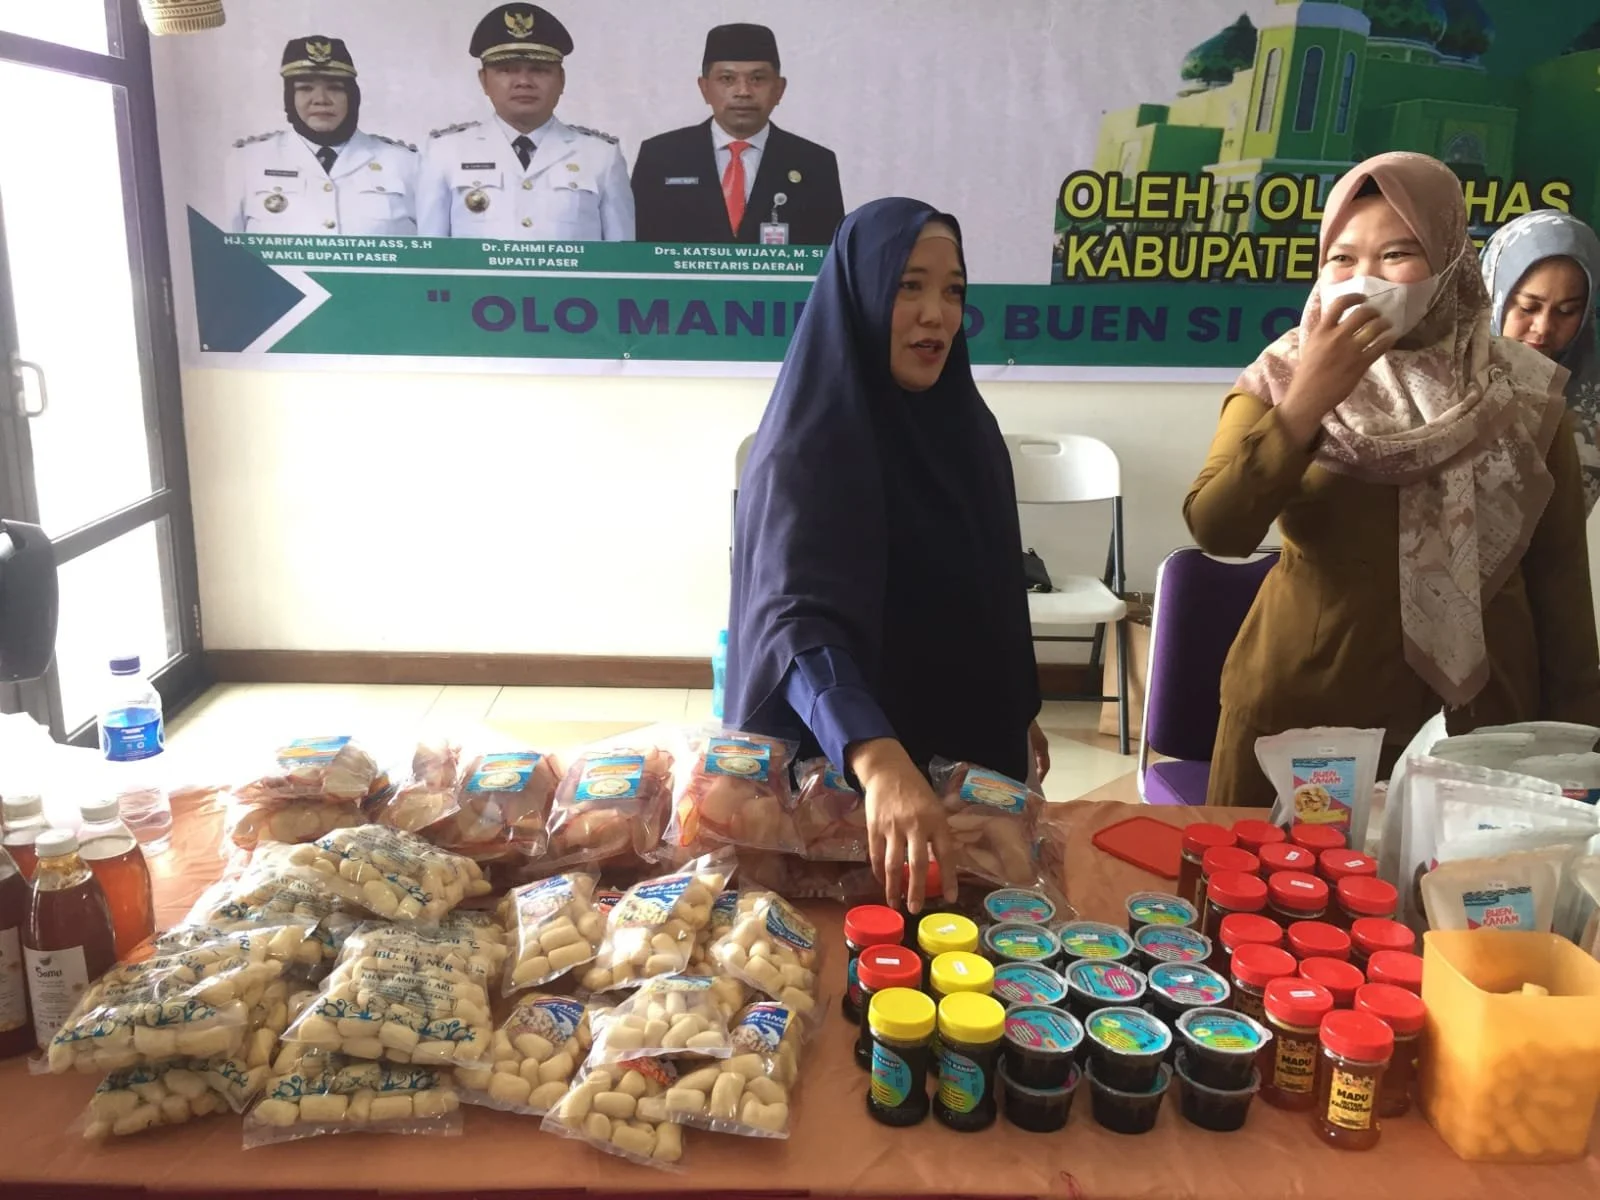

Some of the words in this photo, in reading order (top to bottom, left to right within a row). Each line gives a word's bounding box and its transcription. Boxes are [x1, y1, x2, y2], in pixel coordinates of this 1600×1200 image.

[1061, 172, 1213, 222] OLEH
[1257, 174, 1326, 222] OL
[1463, 178, 1572, 223] HAS
[223, 236, 245, 245] HJ.
[247, 236, 314, 247] SYARIFAH
[316, 237, 376, 248] MASITAH
[378, 239, 408, 250] ASS,
[411, 240, 433, 249] S.H
[481, 242, 501, 252] Dr.
[503, 243, 546, 253] FAHMI
[548, 244, 585, 254] FADLI
[260, 250, 305, 260] WAKIL
[306, 251, 354, 261] BUPATI
[356, 252, 398, 262] PASER
[653, 246, 681, 256] Drs.
[683, 247, 733, 257] KATSUL
[735, 248, 791, 259] WIJAYA,
[793, 249, 809, 258] M.
[811, 249, 824, 258] SI
[1064, 233, 1318, 281] KABUPATE
[488, 256, 536, 267] BUPATI
[538, 258, 579, 268] PASER
[673, 260, 750, 271] SEKRETARIS
[752, 262, 805, 272] DAERAH
[471, 295, 599, 334] OLO
[1004, 304, 1168, 343] BUEN
[1186, 306, 1243, 343] SI
[1282, 1055, 1312, 1066] MADU
[1336, 1088, 1369, 1102] MADU
